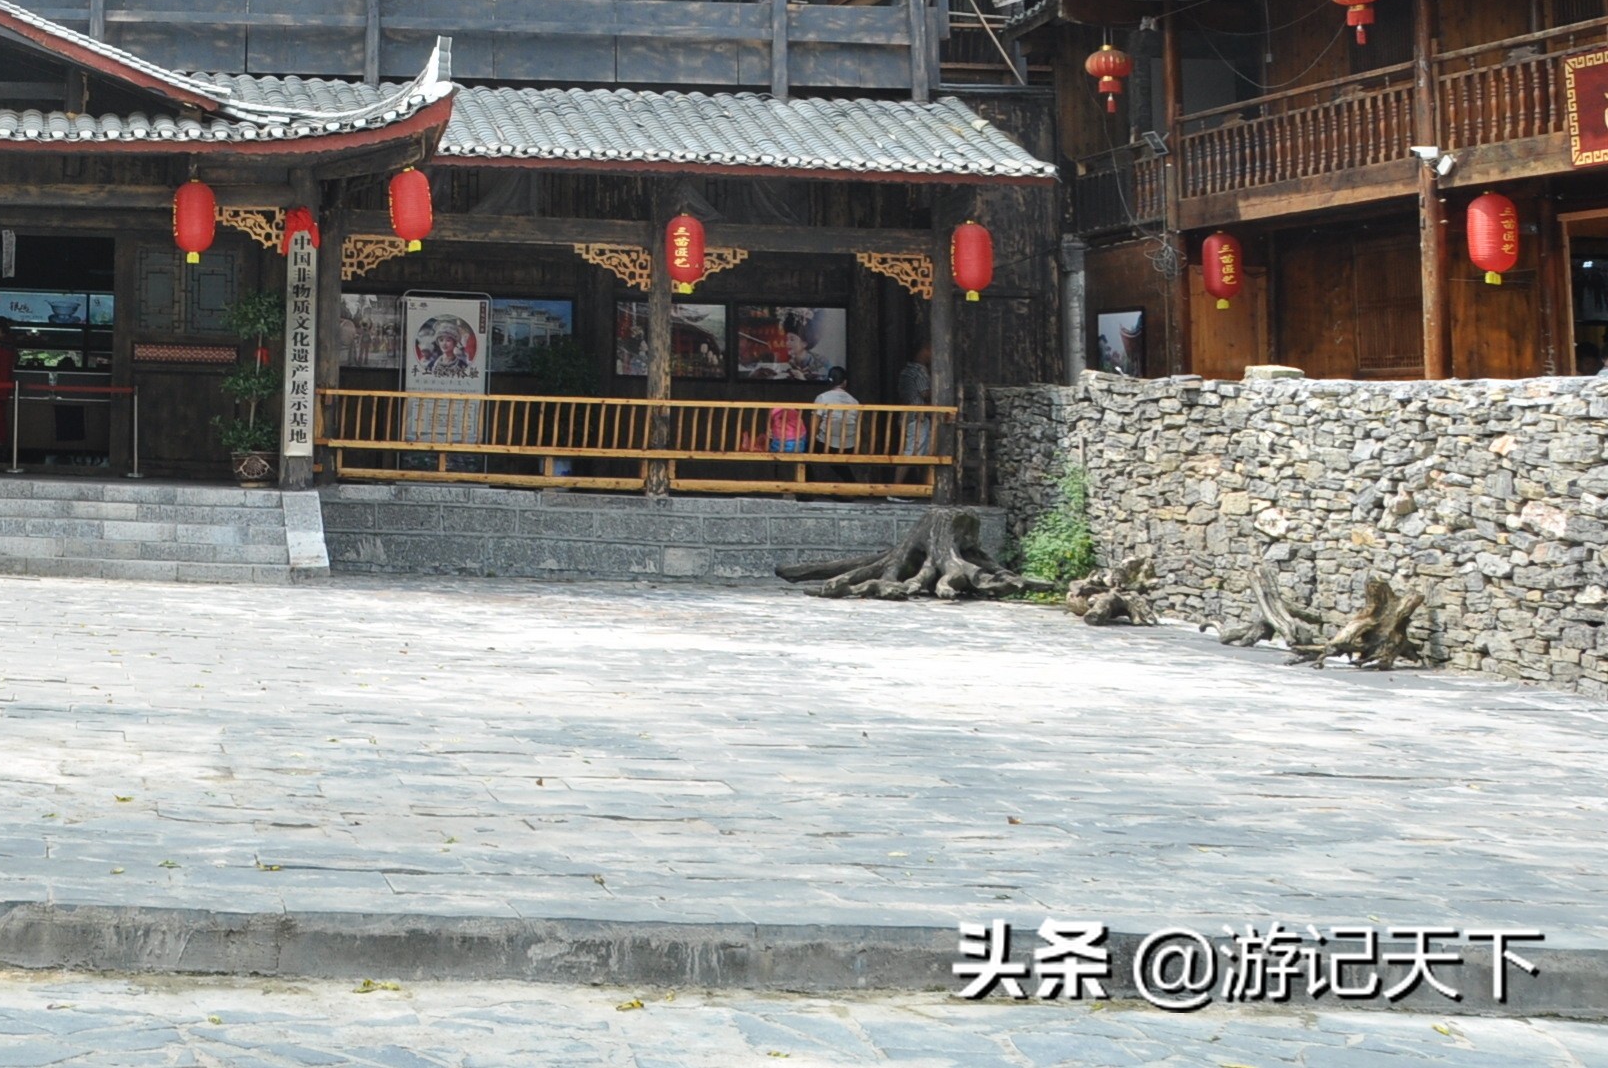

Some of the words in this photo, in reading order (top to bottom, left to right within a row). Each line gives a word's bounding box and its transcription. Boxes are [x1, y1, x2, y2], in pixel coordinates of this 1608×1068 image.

[288, 235, 312, 444] 中国非物质文化遗产展示基地
